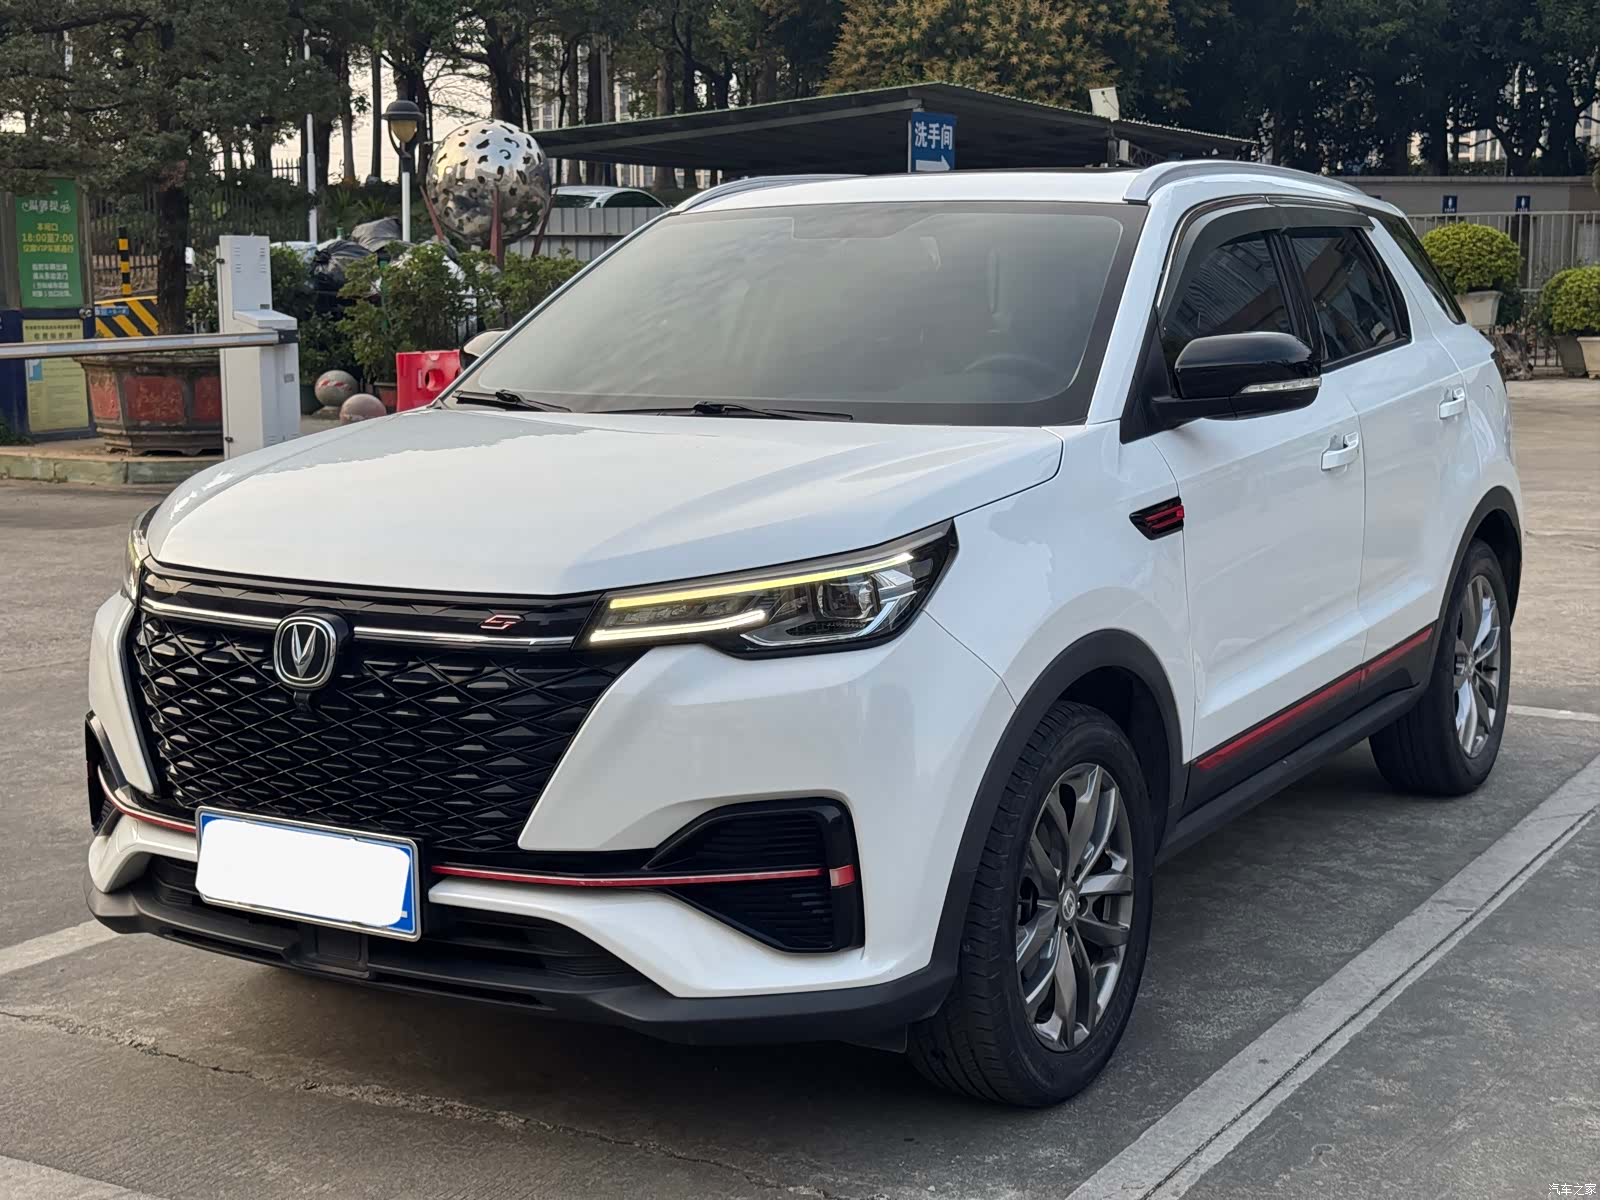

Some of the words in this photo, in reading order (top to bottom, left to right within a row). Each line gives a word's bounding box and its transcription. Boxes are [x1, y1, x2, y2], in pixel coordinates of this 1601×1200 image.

[915, 121, 953, 150] 洗手间
[22, 233, 74, 243] 18:00至7:00
